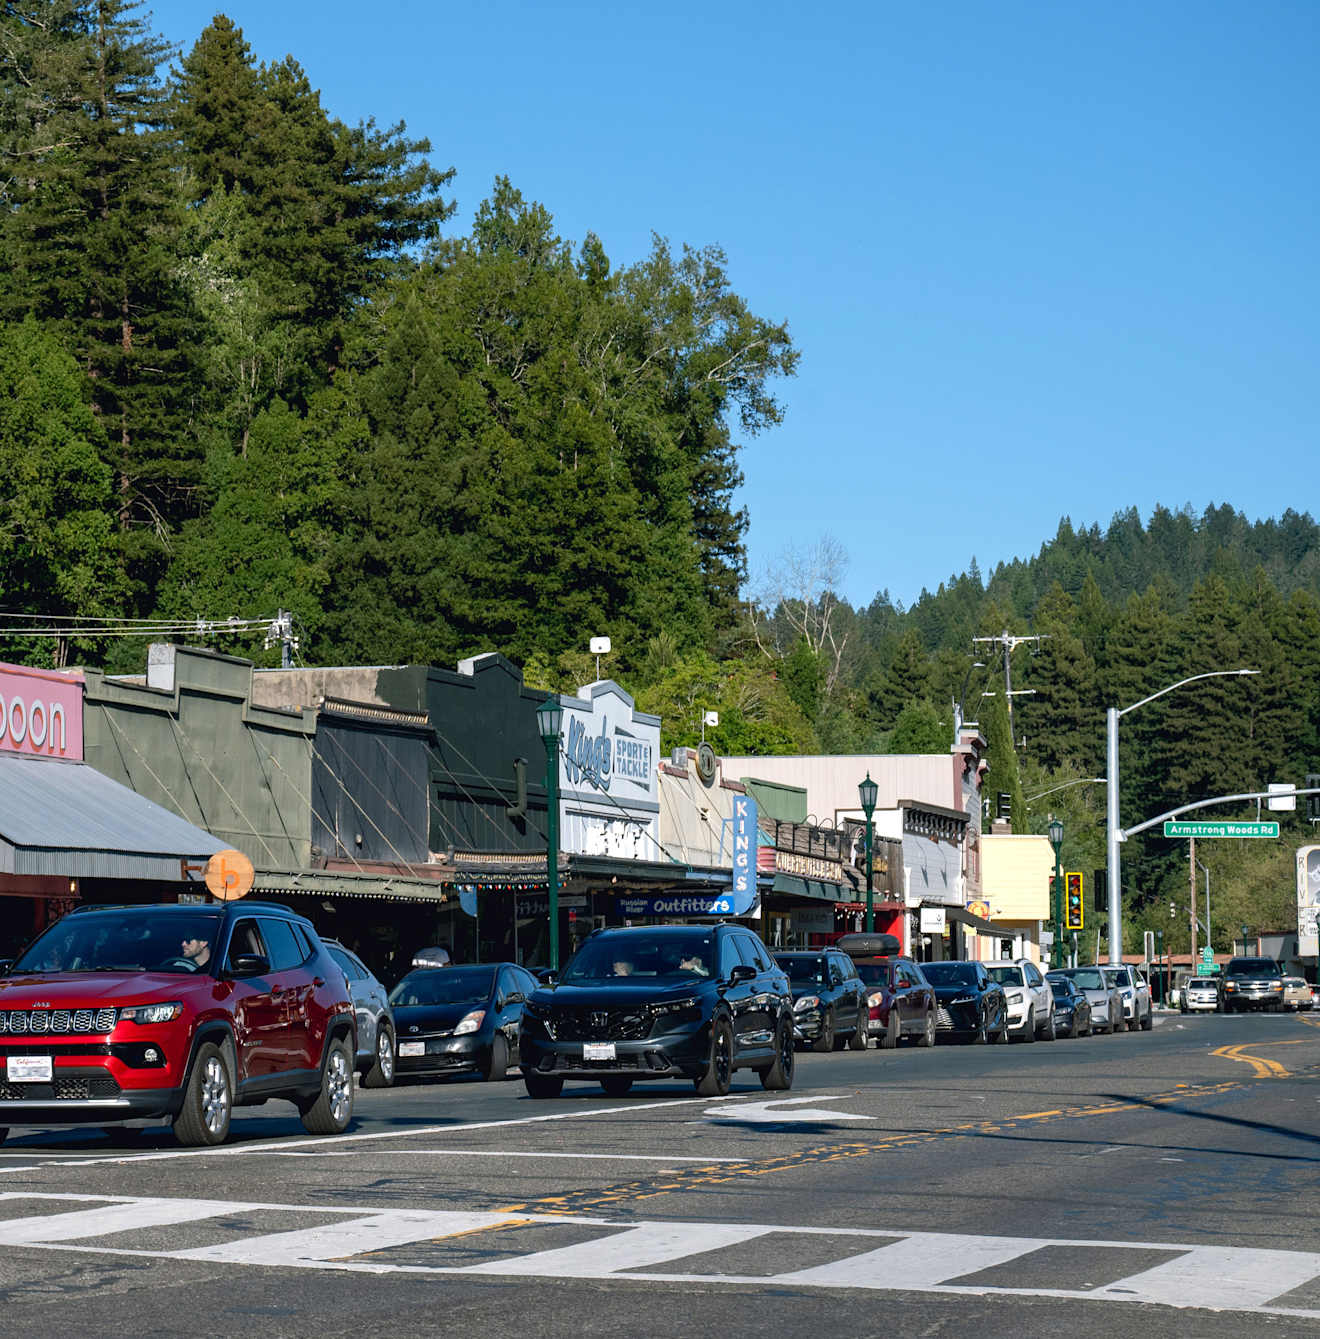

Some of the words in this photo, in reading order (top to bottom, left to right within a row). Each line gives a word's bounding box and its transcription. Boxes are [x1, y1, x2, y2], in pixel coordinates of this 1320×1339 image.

[616, 739, 642, 760] SPORT
[617, 759, 648, 779] TACKLE
[1171, 825, 1225, 836] Armstrong
[1227, 825, 1259, 834] Woods
[1260, 825, 1274, 834] Rd
[735, 801, 749, 891] KING'S
[221, 858, 240, 889] b
[654, 898, 730, 912] Outfitters
